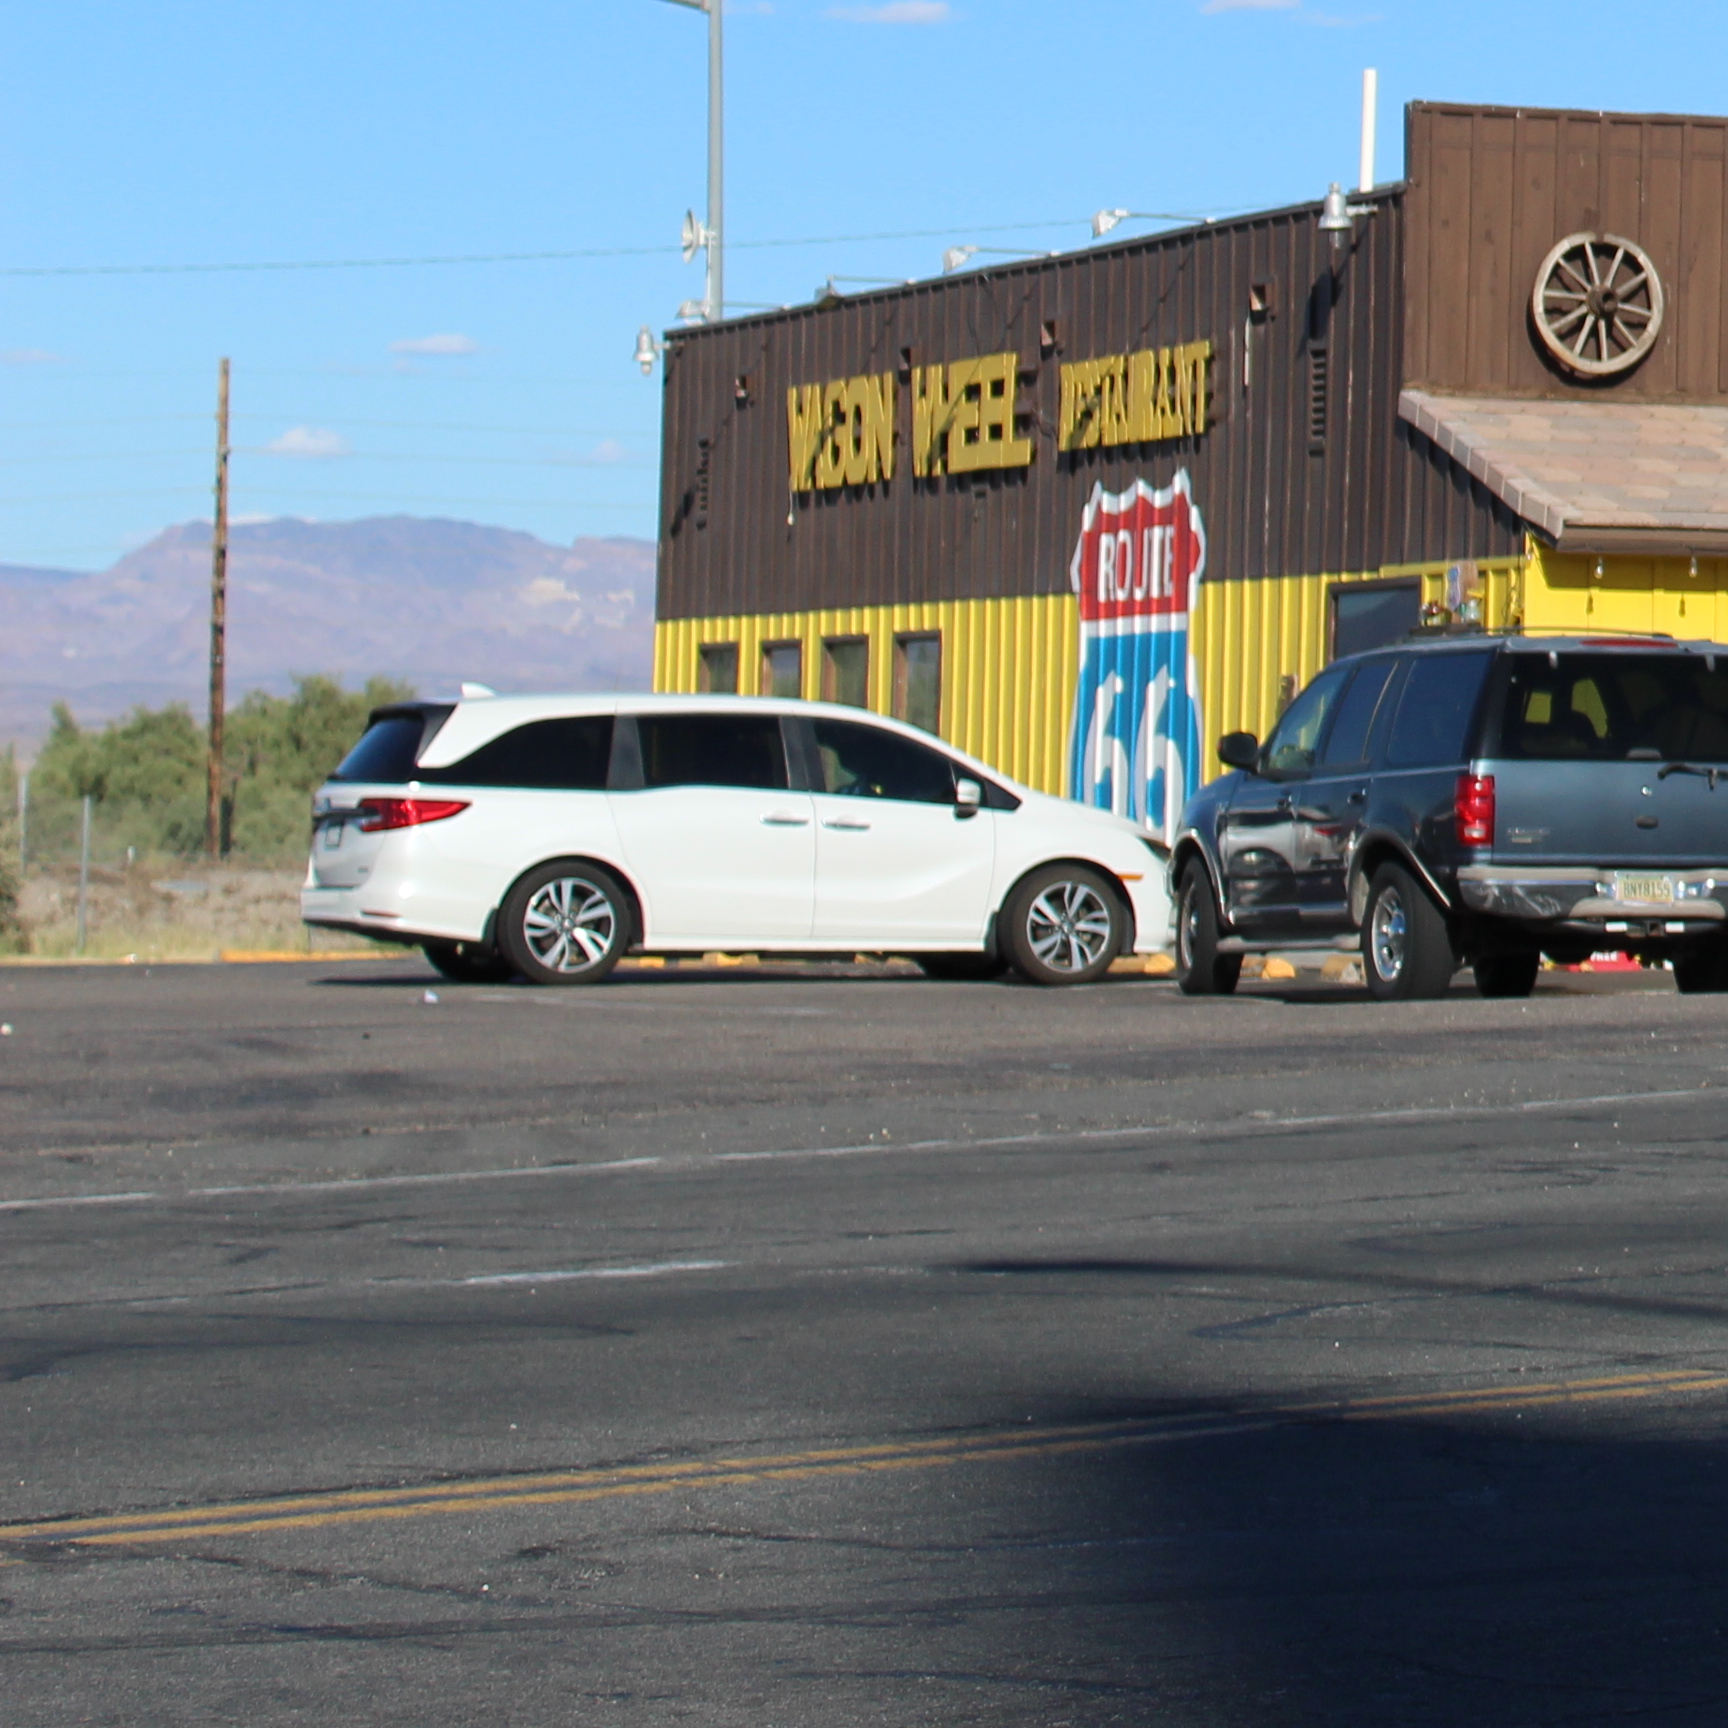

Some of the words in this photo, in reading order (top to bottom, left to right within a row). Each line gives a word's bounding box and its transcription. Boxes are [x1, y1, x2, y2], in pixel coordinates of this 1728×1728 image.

[787, 371, 895, 492] WAGON
[911, 351, 1031, 478] WHEEL
[1058, 339, 1210, 452] RESTAURANT
[1098, 524, 1175, 602] ROUTE
[1084, 663, 1184, 848] 66
